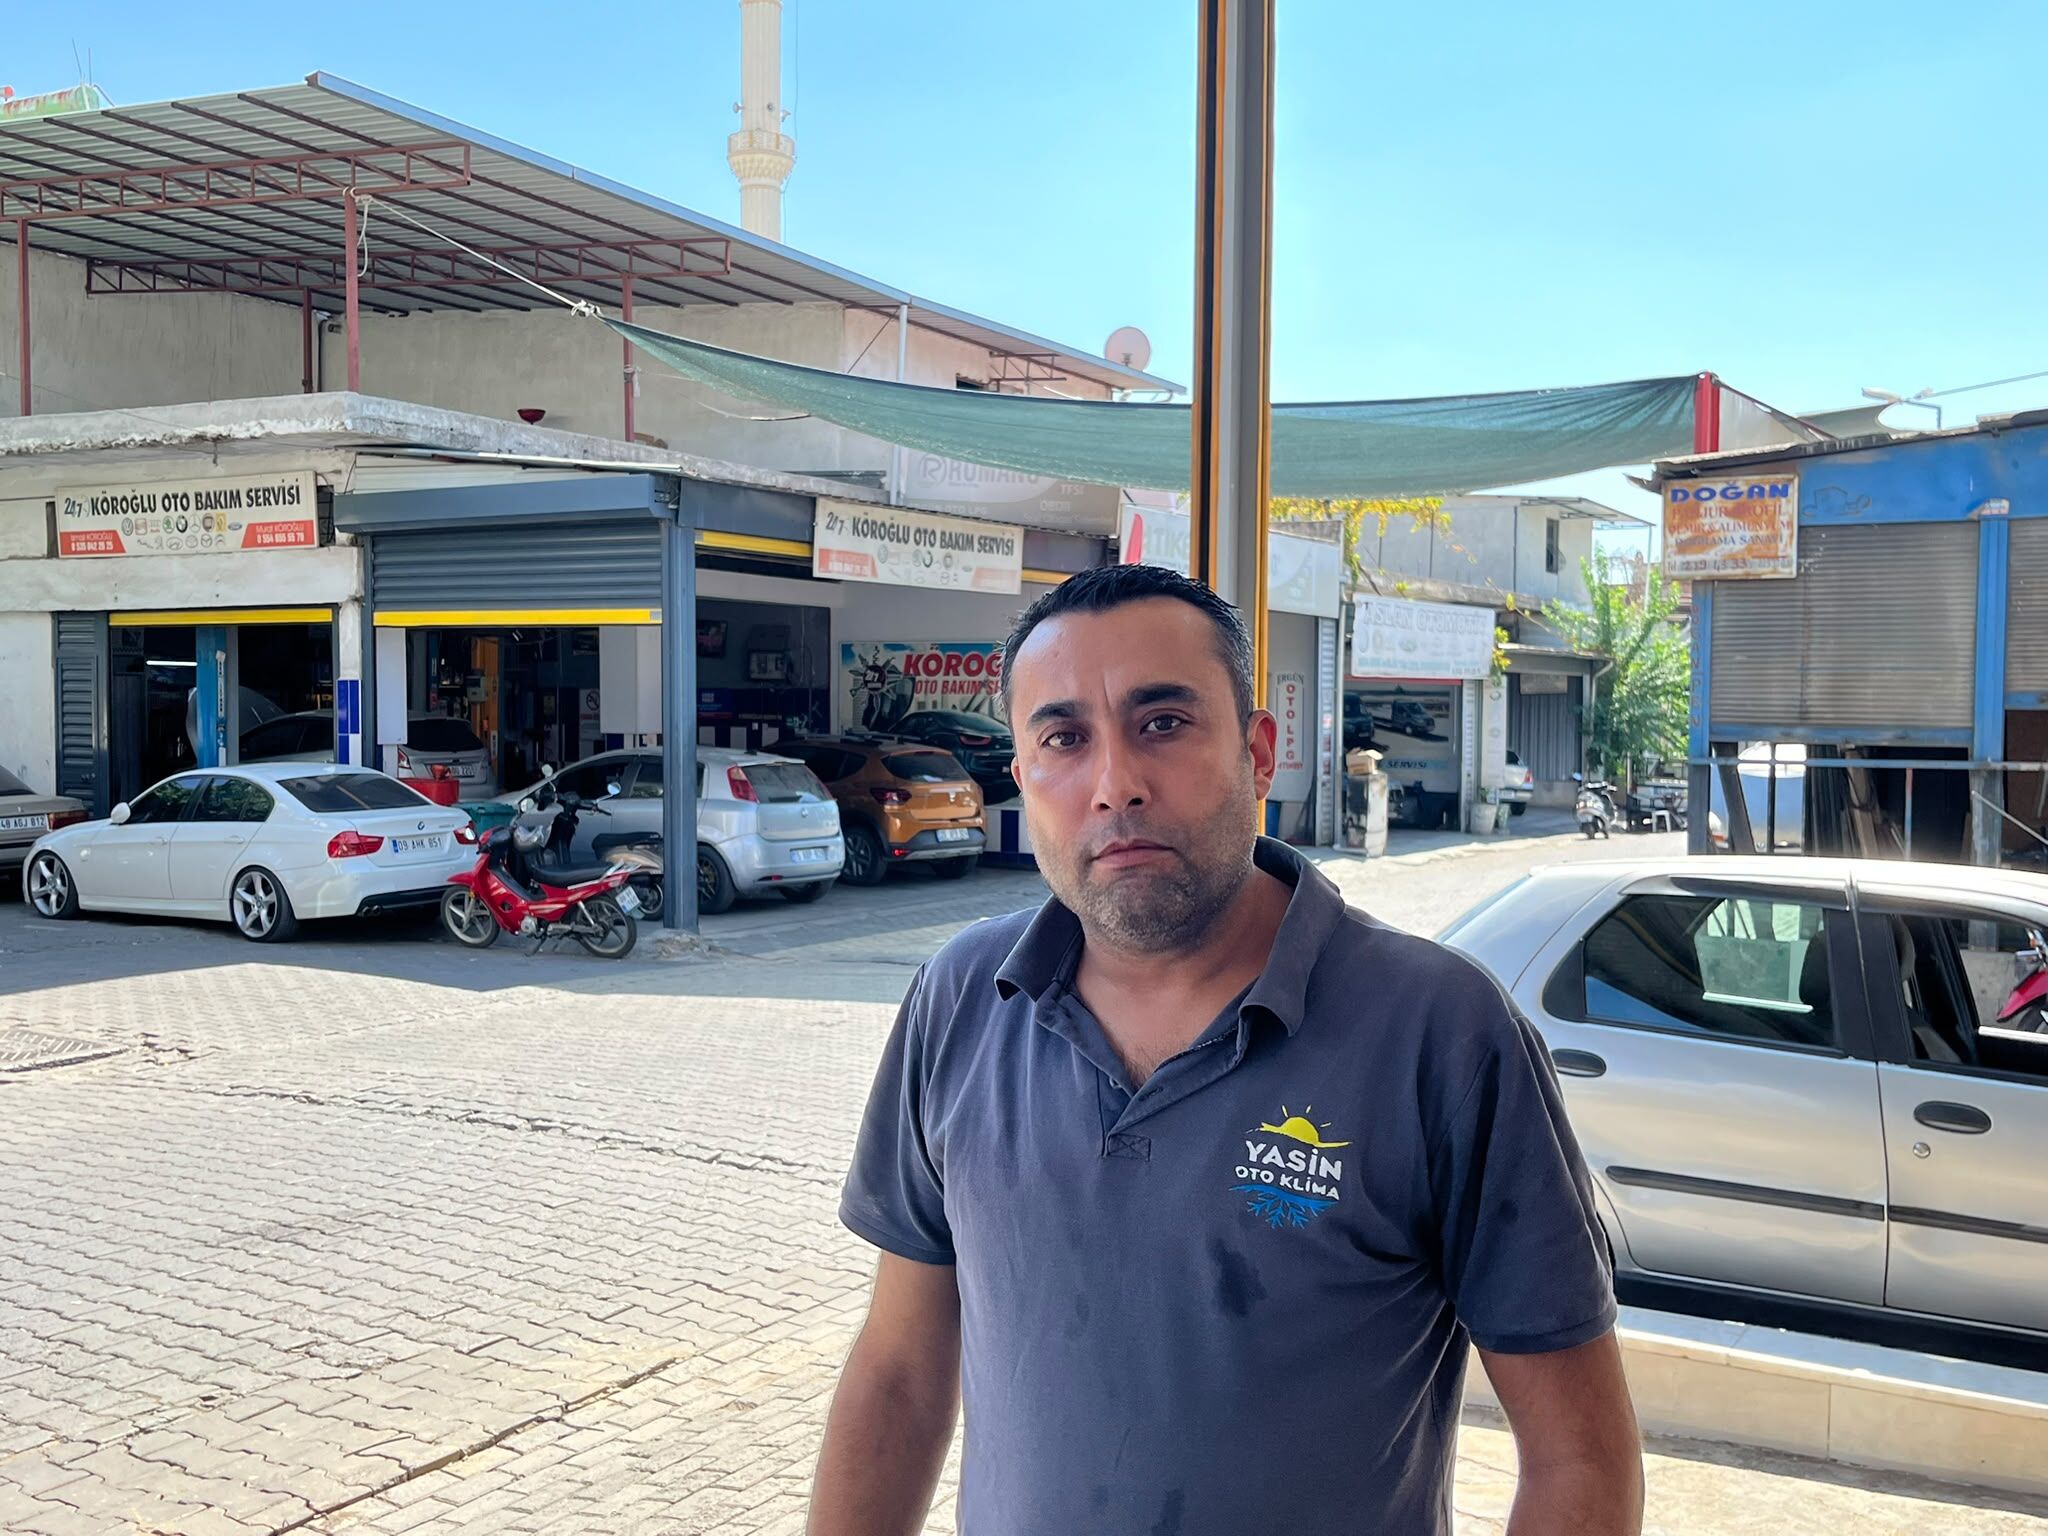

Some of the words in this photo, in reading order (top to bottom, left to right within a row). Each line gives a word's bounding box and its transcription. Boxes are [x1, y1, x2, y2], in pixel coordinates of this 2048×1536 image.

[91, 489, 157, 516] KÖROĞLU
[161, 492, 191, 512] OTO
[194, 487, 242, 511] BAKIM
[246, 478, 301, 507] SERVİSİ
[1671, 481, 1790, 503] DOĞAN
[852, 512, 910, 545] KÖROĞLU
[913, 526, 936, 548] OTO
[939, 531, 975, 553] BAKIM
[977, 531, 1014, 557] SERVİSİ
[916, 680, 938, 695] OTO
[941, 680, 982, 695] BAKIM
[398, 840, 409, 851] 09
[1245, 1140, 1342, 1181] YASİN
[1235, 1165, 1275, 1184] OTO
[1279, 1174, 1340, 1200] KLİMA
